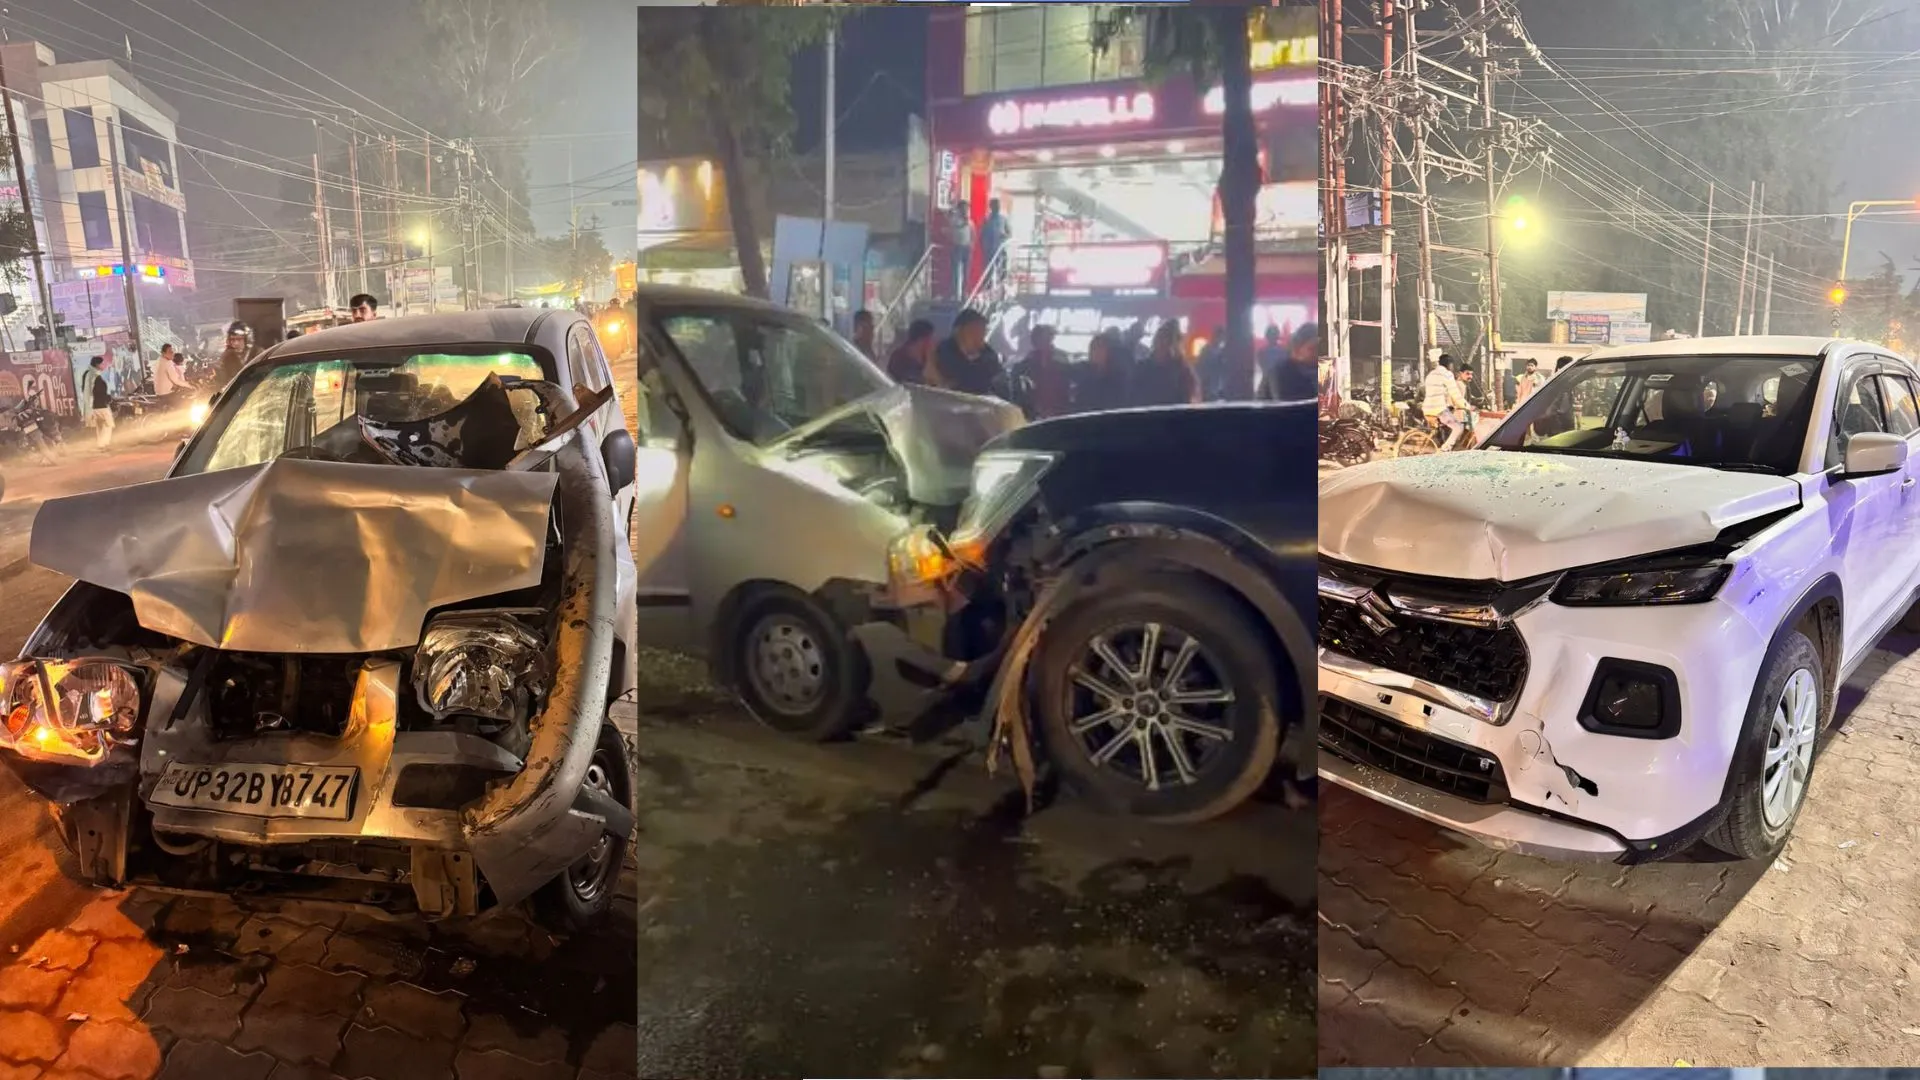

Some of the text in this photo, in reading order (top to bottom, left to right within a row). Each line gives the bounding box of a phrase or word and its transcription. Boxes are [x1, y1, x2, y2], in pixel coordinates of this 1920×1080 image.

[35, 363, 53, 372] UPTO
[55, 397, 74, 417] OFF
[174, 769, 350, 808] UP32BY8747
